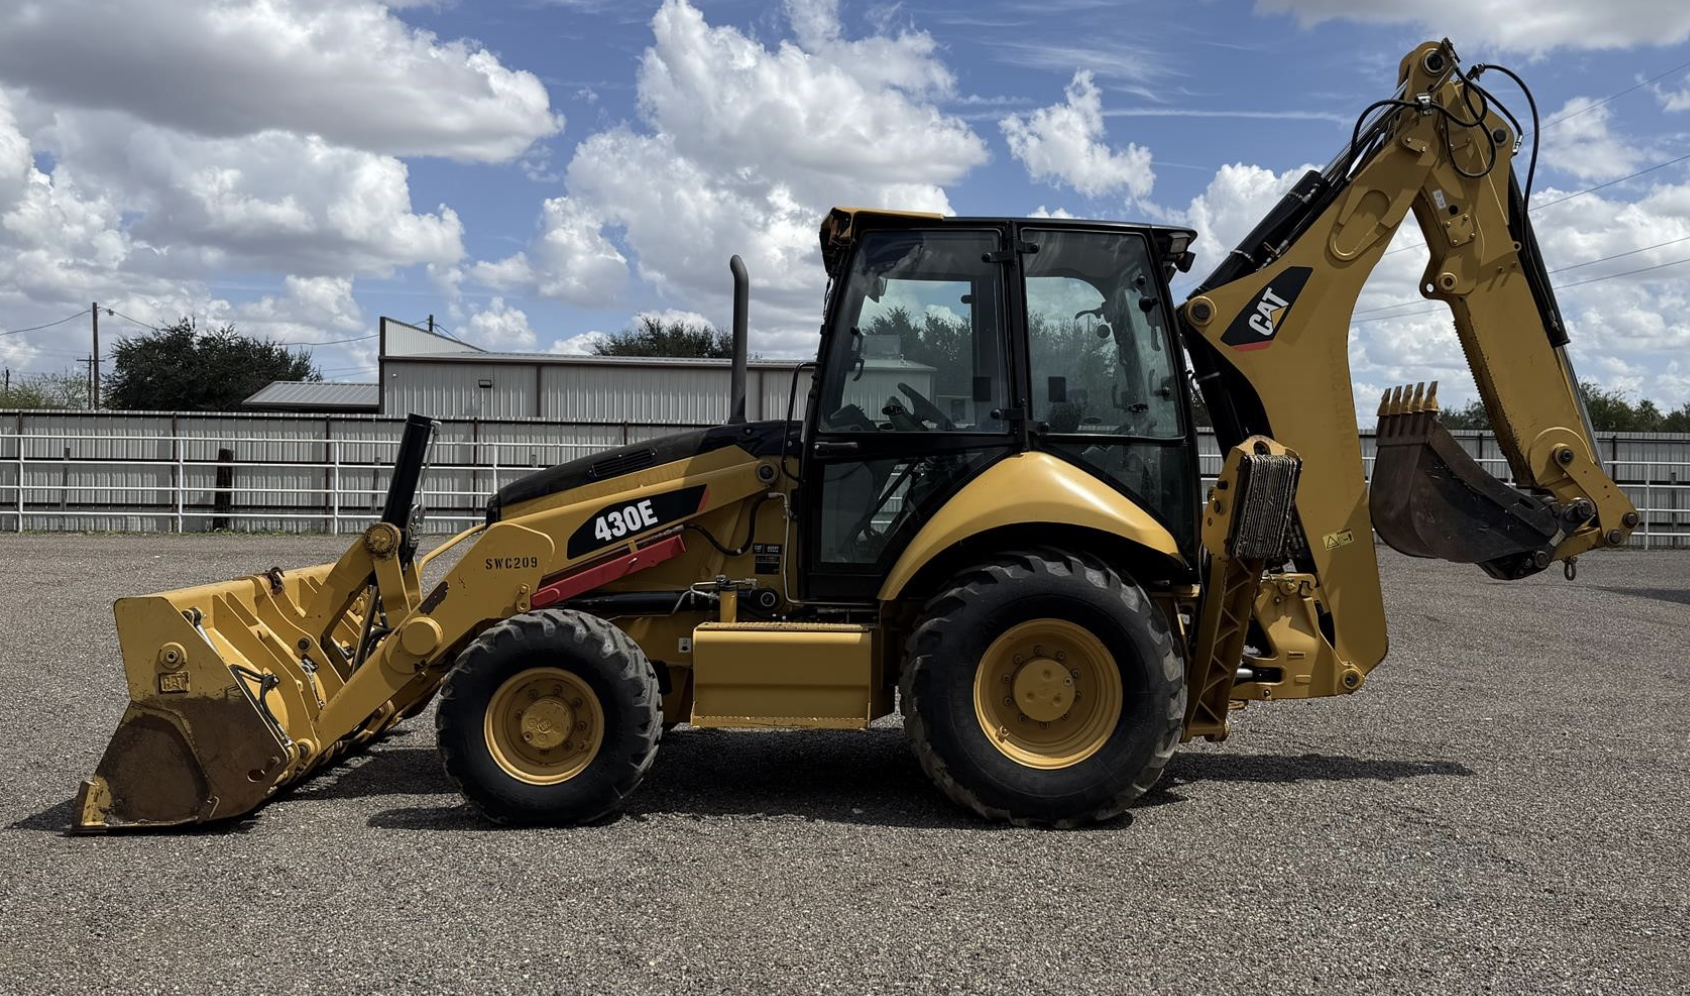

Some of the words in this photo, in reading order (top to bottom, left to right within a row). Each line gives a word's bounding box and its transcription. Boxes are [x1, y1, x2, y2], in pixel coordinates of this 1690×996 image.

[1249, 287, 1289, 336] CAT
[595, 499, 658, 542] 430E
[485, 557, 538, 570] SWC209
